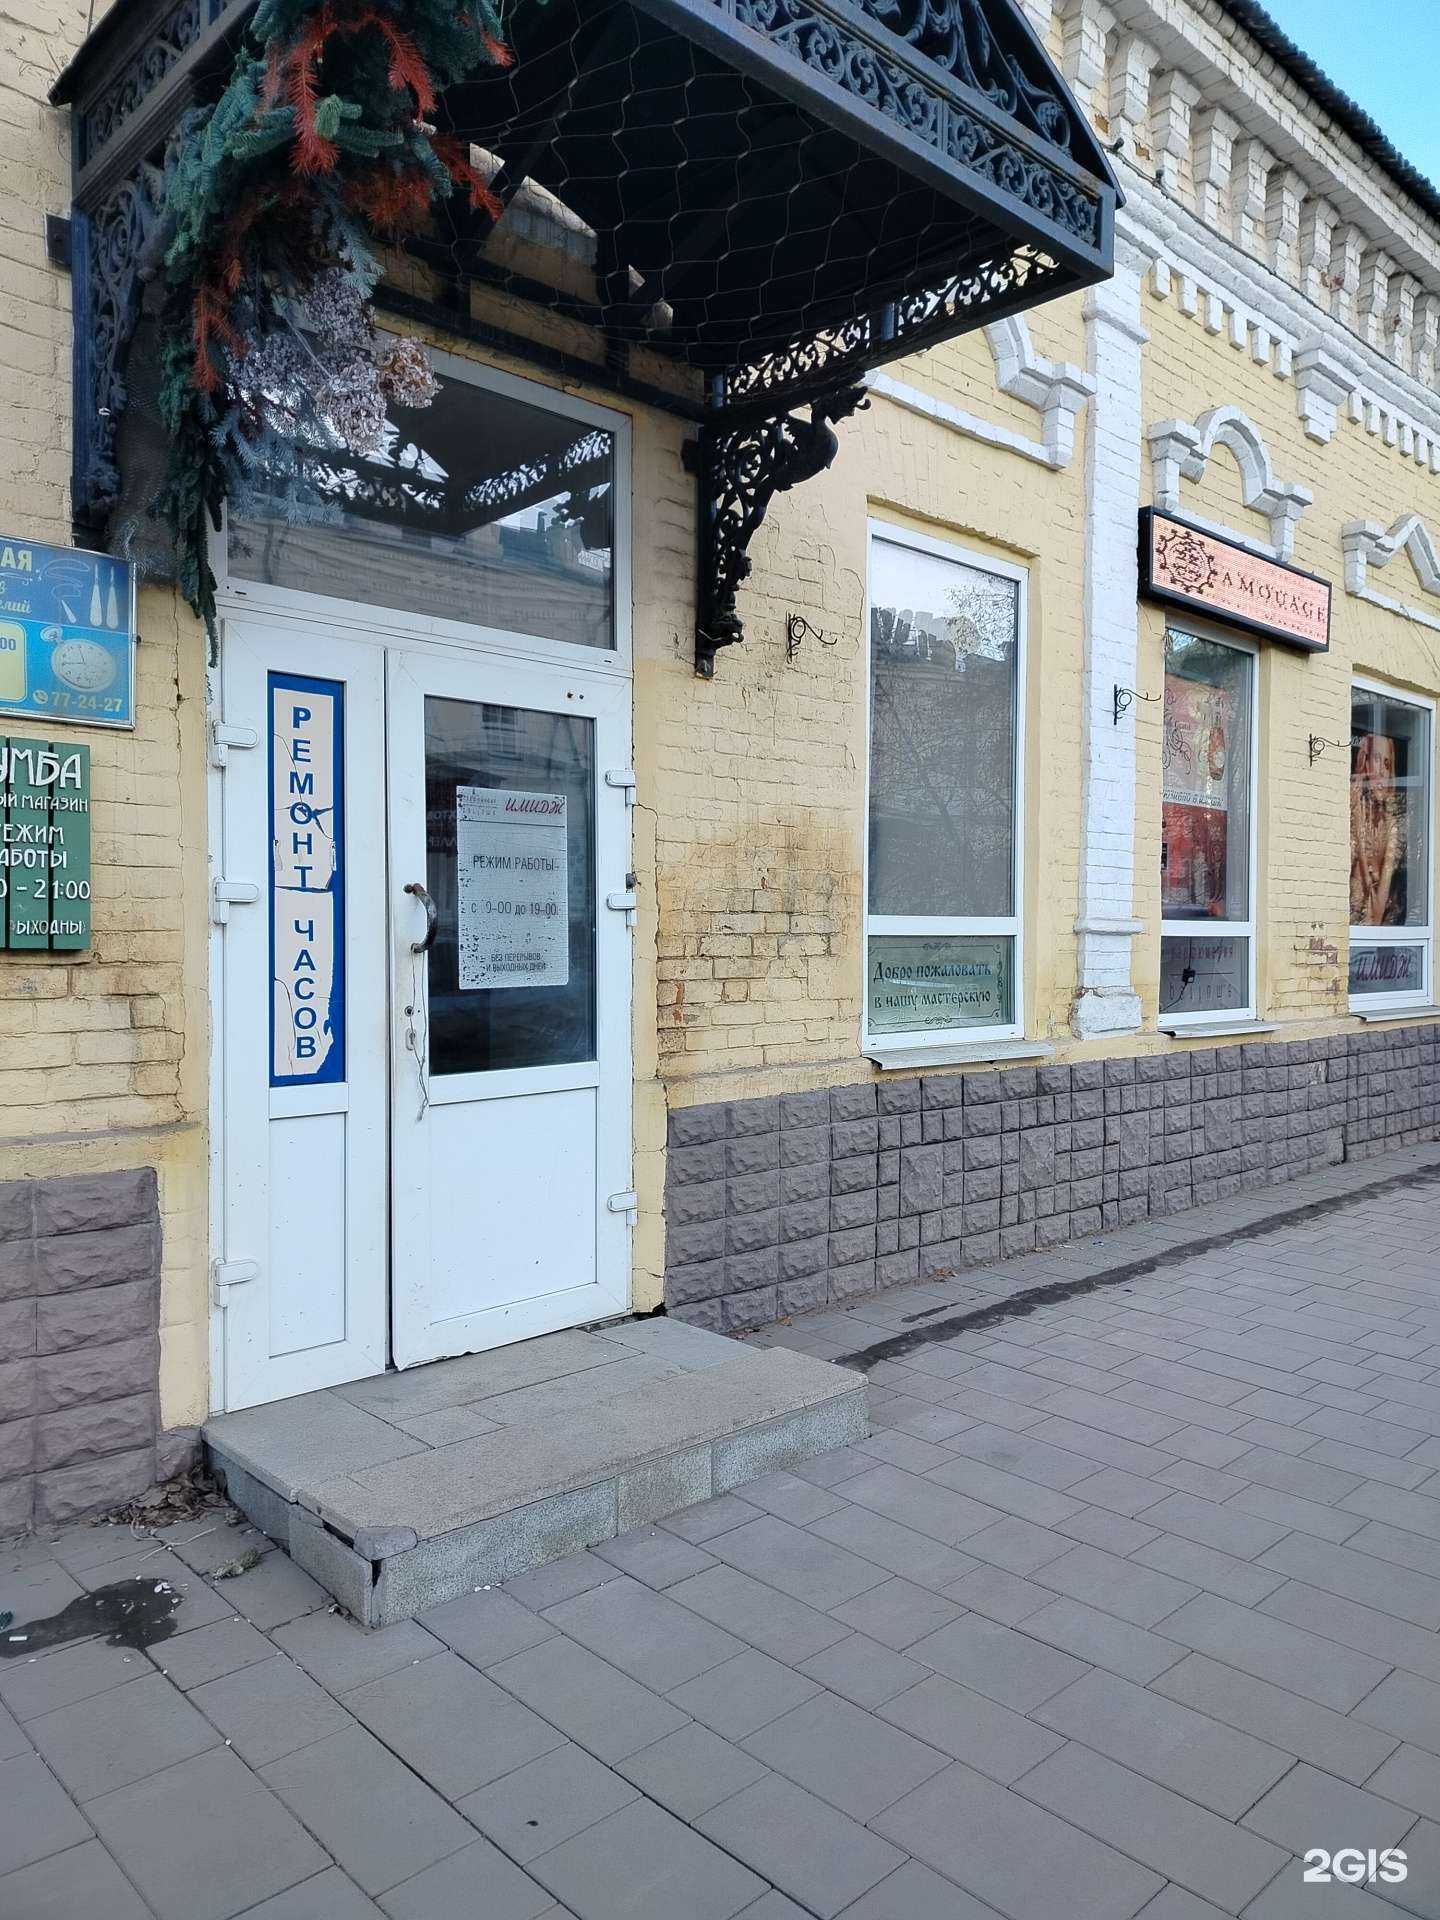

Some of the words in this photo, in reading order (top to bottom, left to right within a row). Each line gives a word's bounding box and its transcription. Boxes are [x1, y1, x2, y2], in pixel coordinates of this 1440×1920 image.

[51, 691, 122, 712] 77-24-27
[22, 794, 88, 812] МАГАЗИН
[290, 706, 314, 888] РЕМОНТ
[0, 823, 64, 844] ЕЖИМ
[473, 855, 511, 870] РЕЖИМ
[514, 857, 554, 871] РАБОТЫ
[33, 879, 90, 899] 21:00
[514, 904, 527, 916] до
[529, 902, 557, 915] 19-00
[10, 920, 86, 935] ЫХОДНЫ
[873, 961, 912, 984] Добро
[916, 963, 991, 979] пожаловать
[293, 919, 317, 1059] ЧАСОВ
[873, 995, 883, 1009] в
[886, 994, 919, 1011] нашу
[921, 990, 991, 1009] мастерскую
